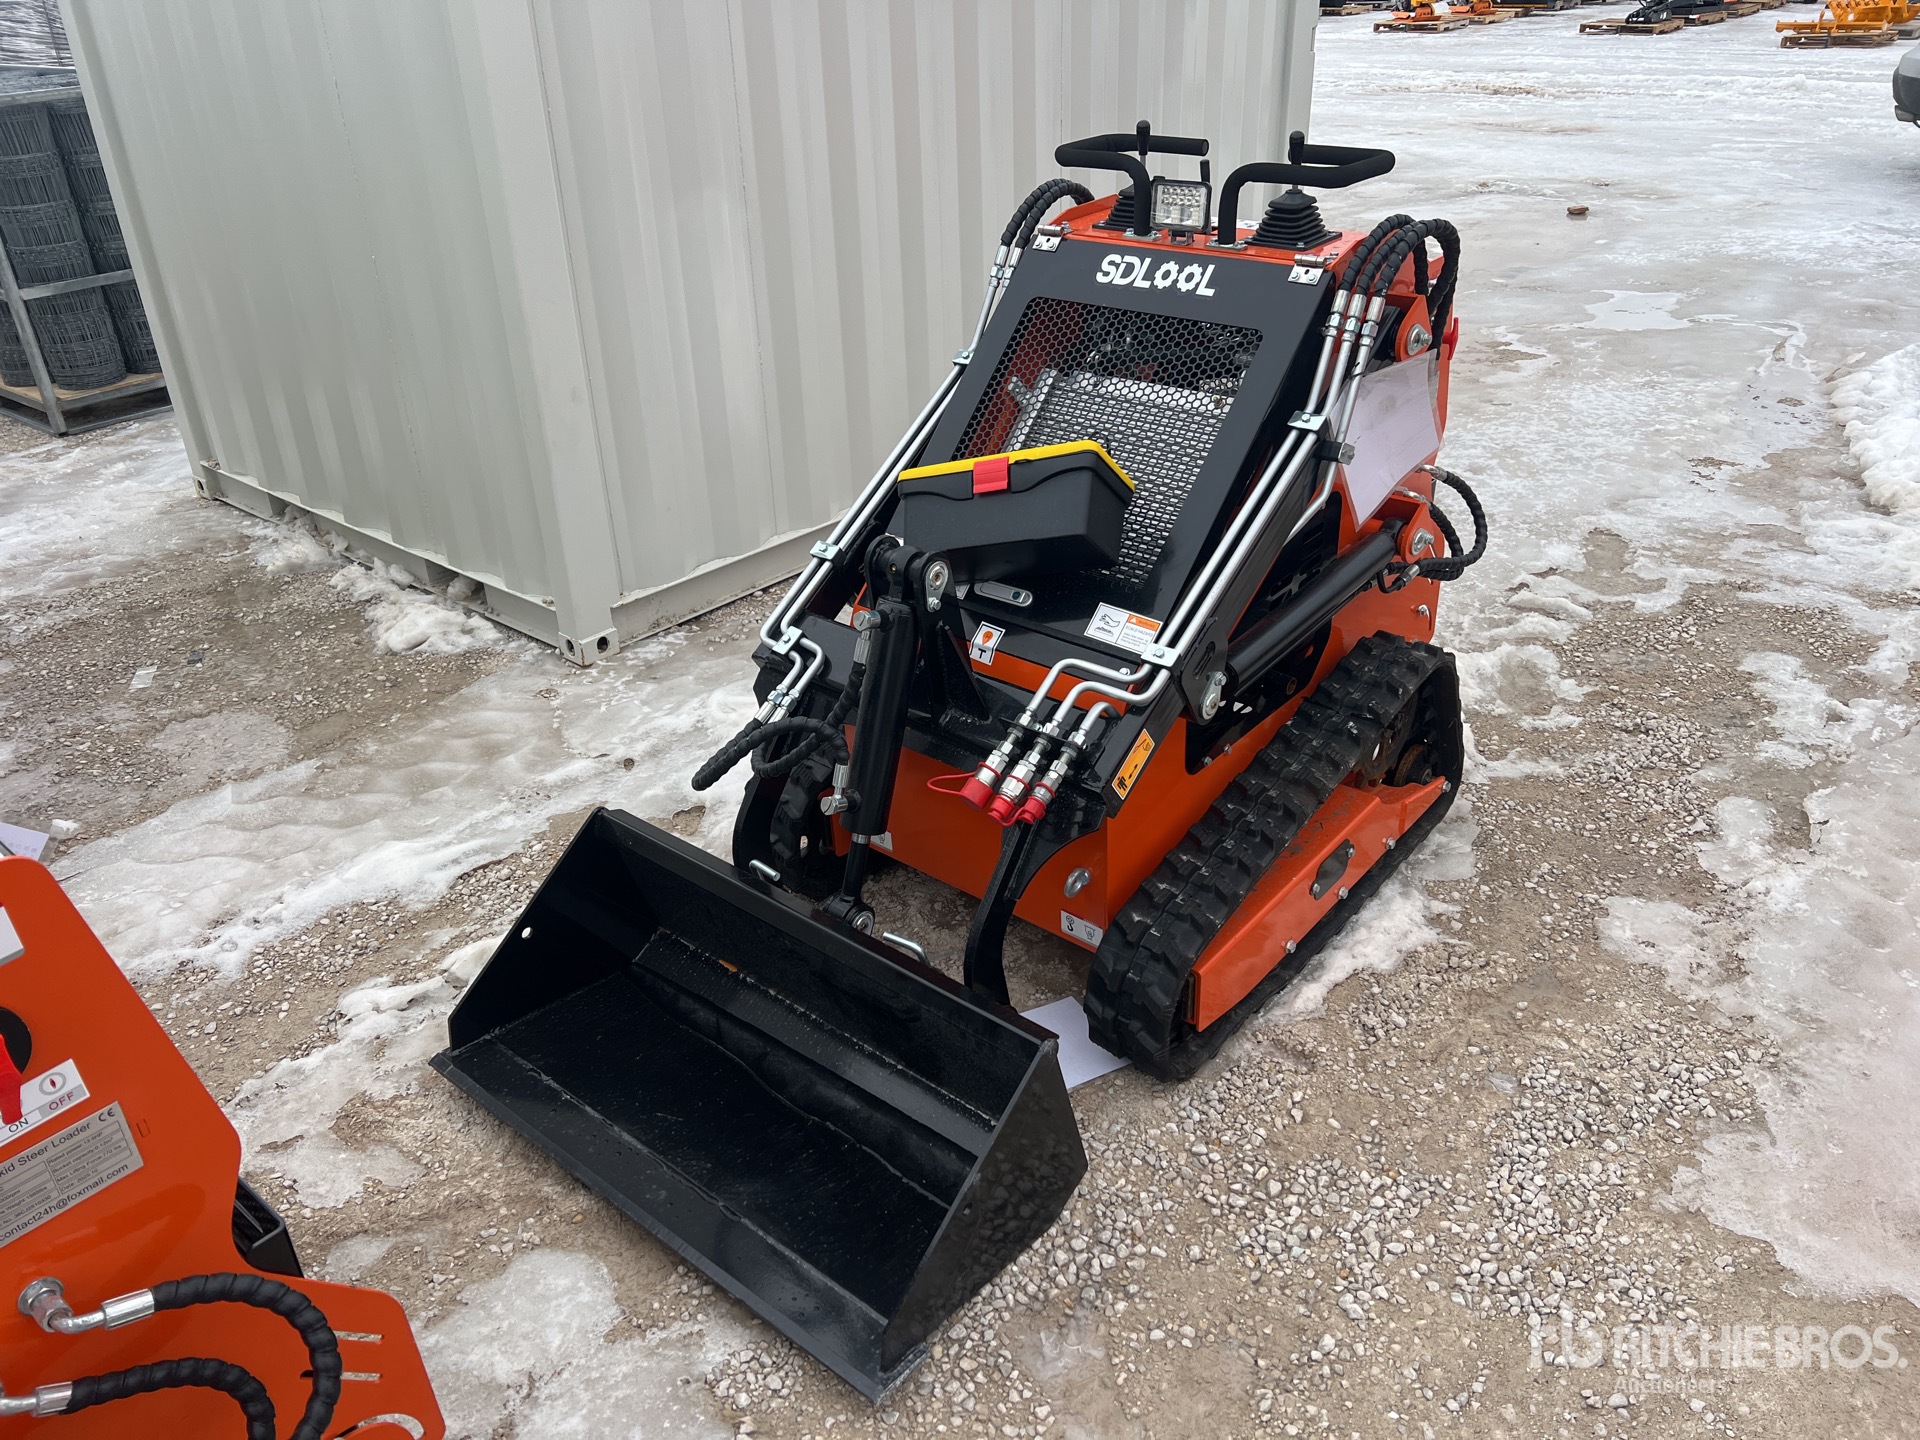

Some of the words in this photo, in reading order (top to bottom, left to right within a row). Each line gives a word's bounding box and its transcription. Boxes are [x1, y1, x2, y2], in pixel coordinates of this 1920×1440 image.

[8, 1117, 29, 1133] ON
[48, 1091, 74, 1111] OFF
[17, 1144, 49, 1167] Steer
[51, 1122, 91, 1148] Loader
